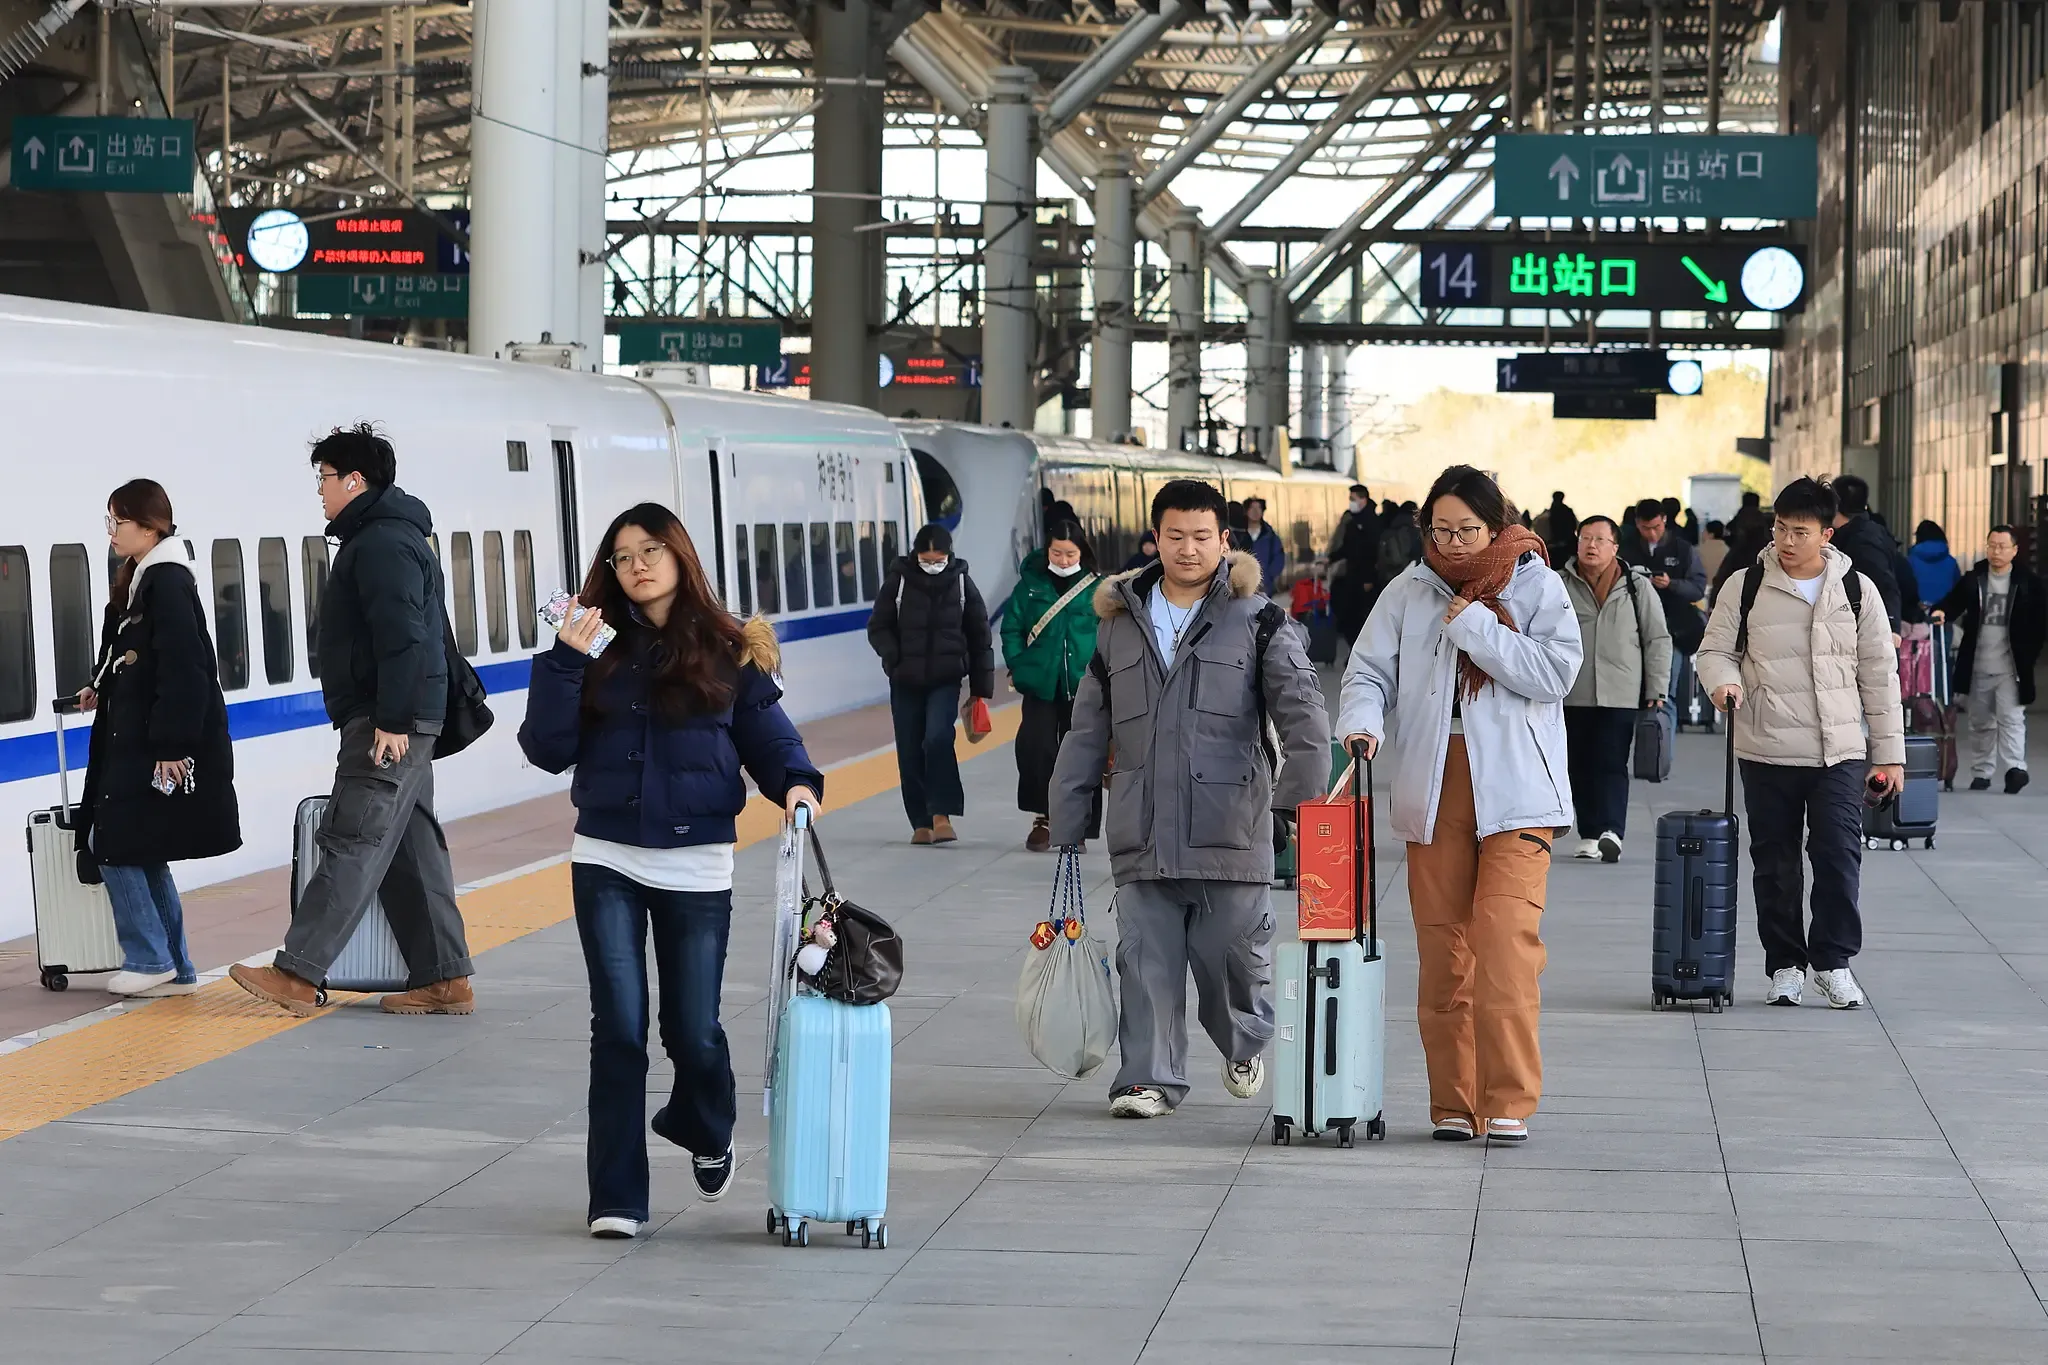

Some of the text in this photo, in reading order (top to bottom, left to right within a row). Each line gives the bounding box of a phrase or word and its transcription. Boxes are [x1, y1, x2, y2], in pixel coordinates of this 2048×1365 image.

[106, 132, 182, 158] 出站口
[106, 160, 136, 176] Exit
[1662, 149, 1763, 180] 出站口
[1662, 185, 1703, 205] Exit
[1430, 252, 1478, 299] 14
[1509, 251, 1638, 298] 出站口
[692, 332, 743, 349] 出站口
